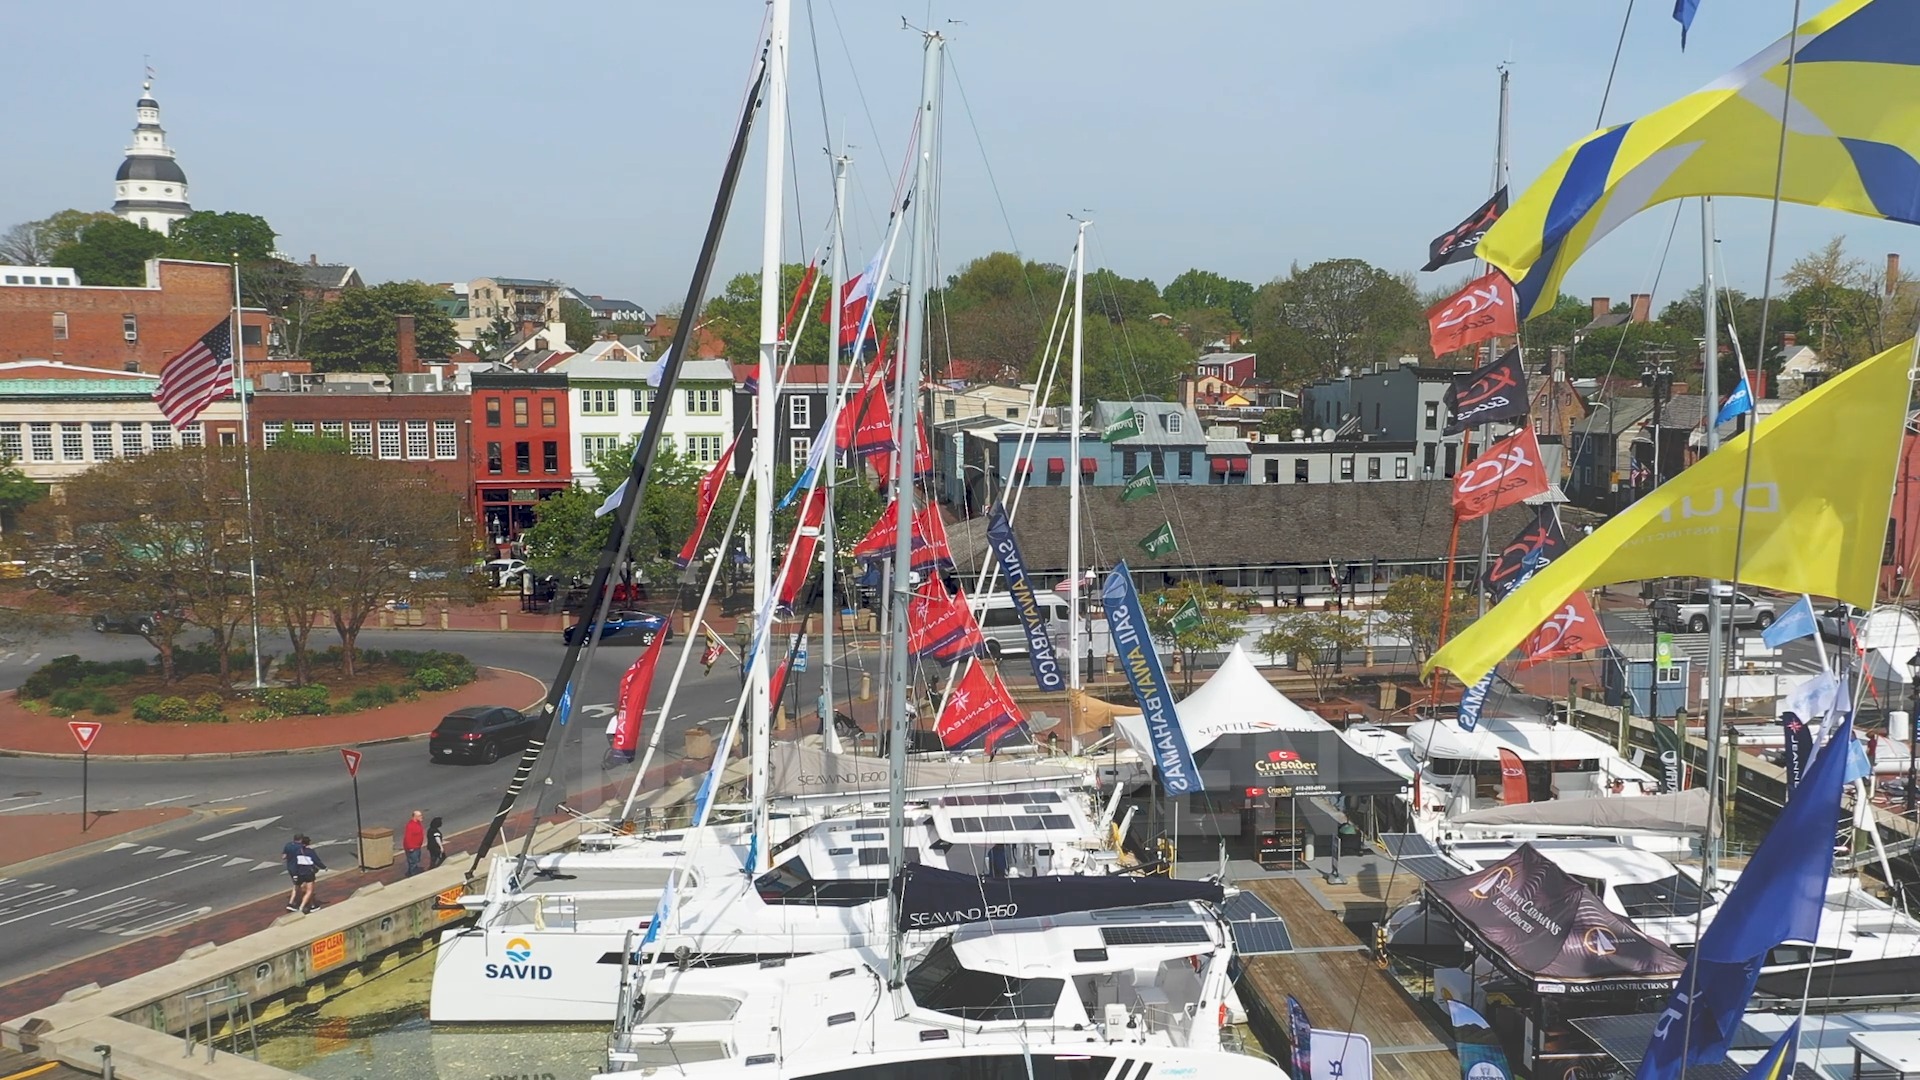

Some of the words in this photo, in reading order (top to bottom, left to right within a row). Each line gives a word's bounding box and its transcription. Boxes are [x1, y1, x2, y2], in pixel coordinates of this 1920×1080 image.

[1254, 759, 1317, 771] Crusader
[797, 773, 857, 787] SEAWIND
[909, 908, 981, 926] SEAWIND
[984, 903, 1019, 919] 1260
[312, 939, 327, 955] KEEP
[327, 932, 344, 949] CLEAR
[485, 963, 553, 980] SAVID
[1569, 983, 1586, 993] ASA
[1586, 983, 1615, 993] SAILING
[1616, 982, 1670, 992] INSTRUCTIONS
